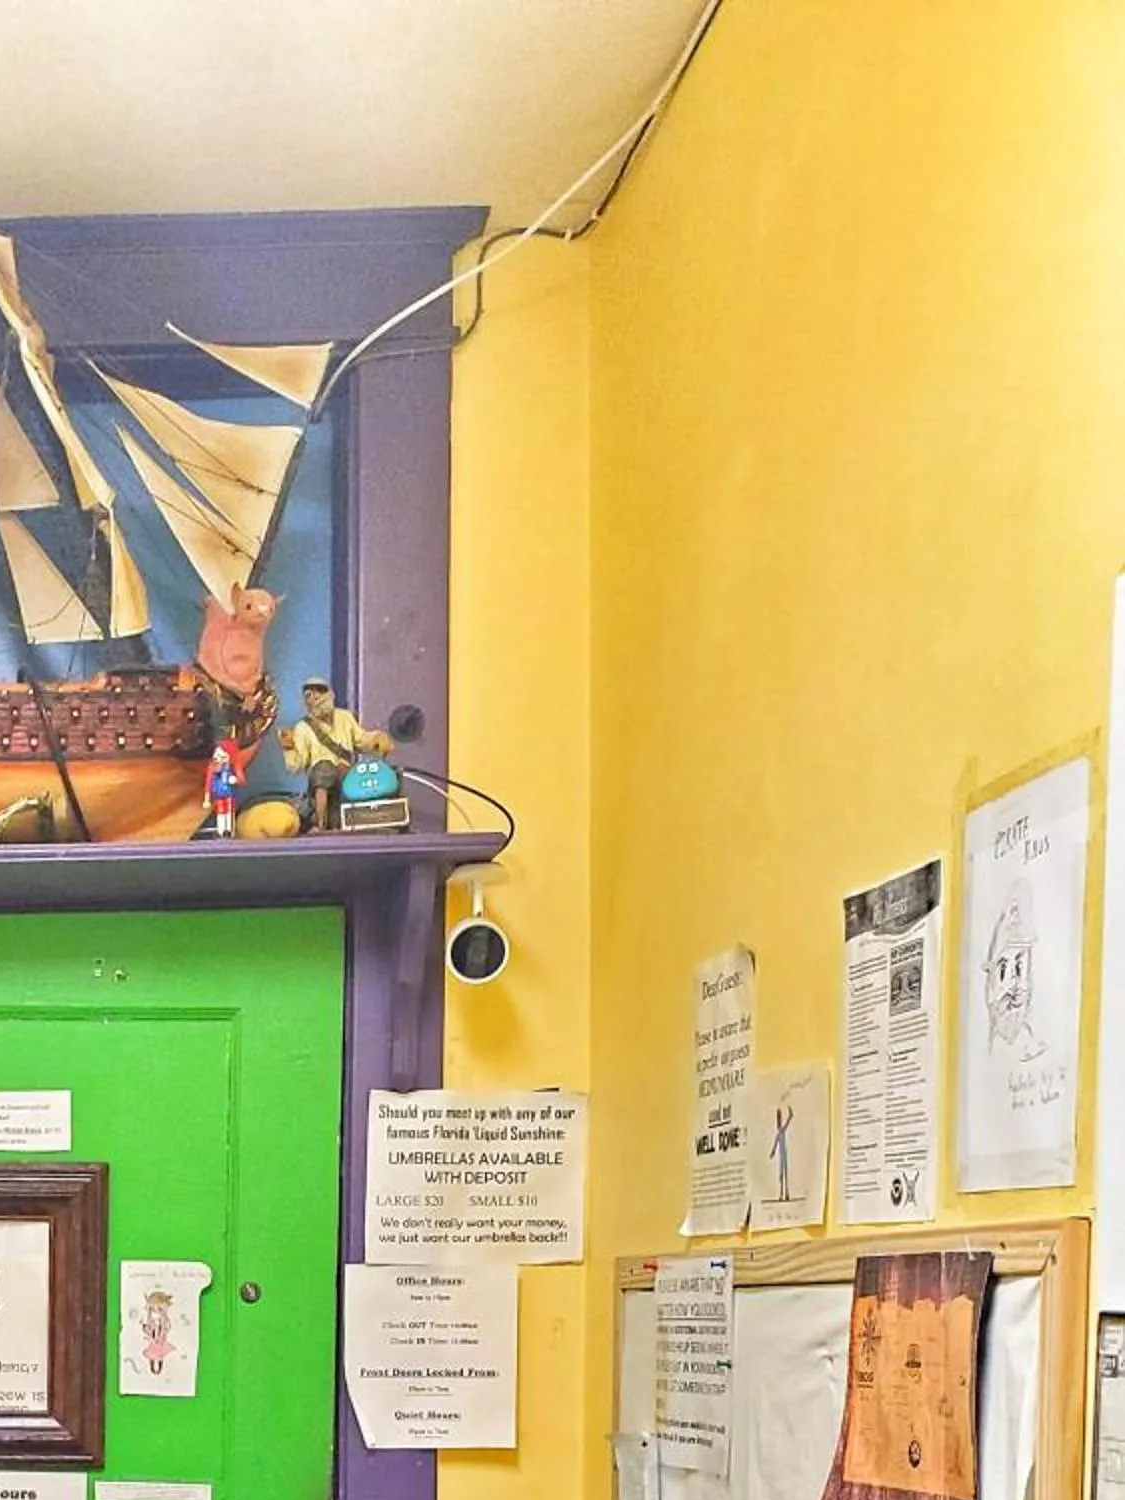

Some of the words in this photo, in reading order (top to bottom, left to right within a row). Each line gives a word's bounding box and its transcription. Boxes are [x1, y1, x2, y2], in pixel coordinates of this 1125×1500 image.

[378, 1103, 418, 1120] Should
[422, 1108, 443, 1122] you
[446, 1107, 472, 1119] meet
[474, 1109, 486, 1122] up
[490, 1105, 512, 1120] with
[516, 1109, 536, 1122] any
[540, 1105, 552, 1120] of
[554, 1108, 575, 1120] our
[386, 1124, 430, 1140] famous
[433, 1124, 470, 1140] Florida
[388, 1151, 475, 1165] UMBRELLAS
[478, 1151, 564, 1165] AVAILABLE
[424, 1171, 462, 1185] WITH
[464, 1171, 528, 1185] DEPOSIT
[376, 1195, 421, 1207] LARGE
[424, 1194, 445, 1207] $20
[469, 1194, 515, 1207] SMALL
[379, 1216, 400, 1229] We
[402, 1216, 433, 1229] don't
[434, 1217, 464, 1230] really
[466, 1218, 495, 1229] want
[498, 1219, 523, 1231] your
[378, 1233, 396, 1243] we
[398, 1232, 418, 1245] just
[422, 1232, 449, 1243] want
[451, 1235, 471, 1244] our
[395, 1276, 428, 1287] Office
[408, 1321, 426, 1329] OUT
